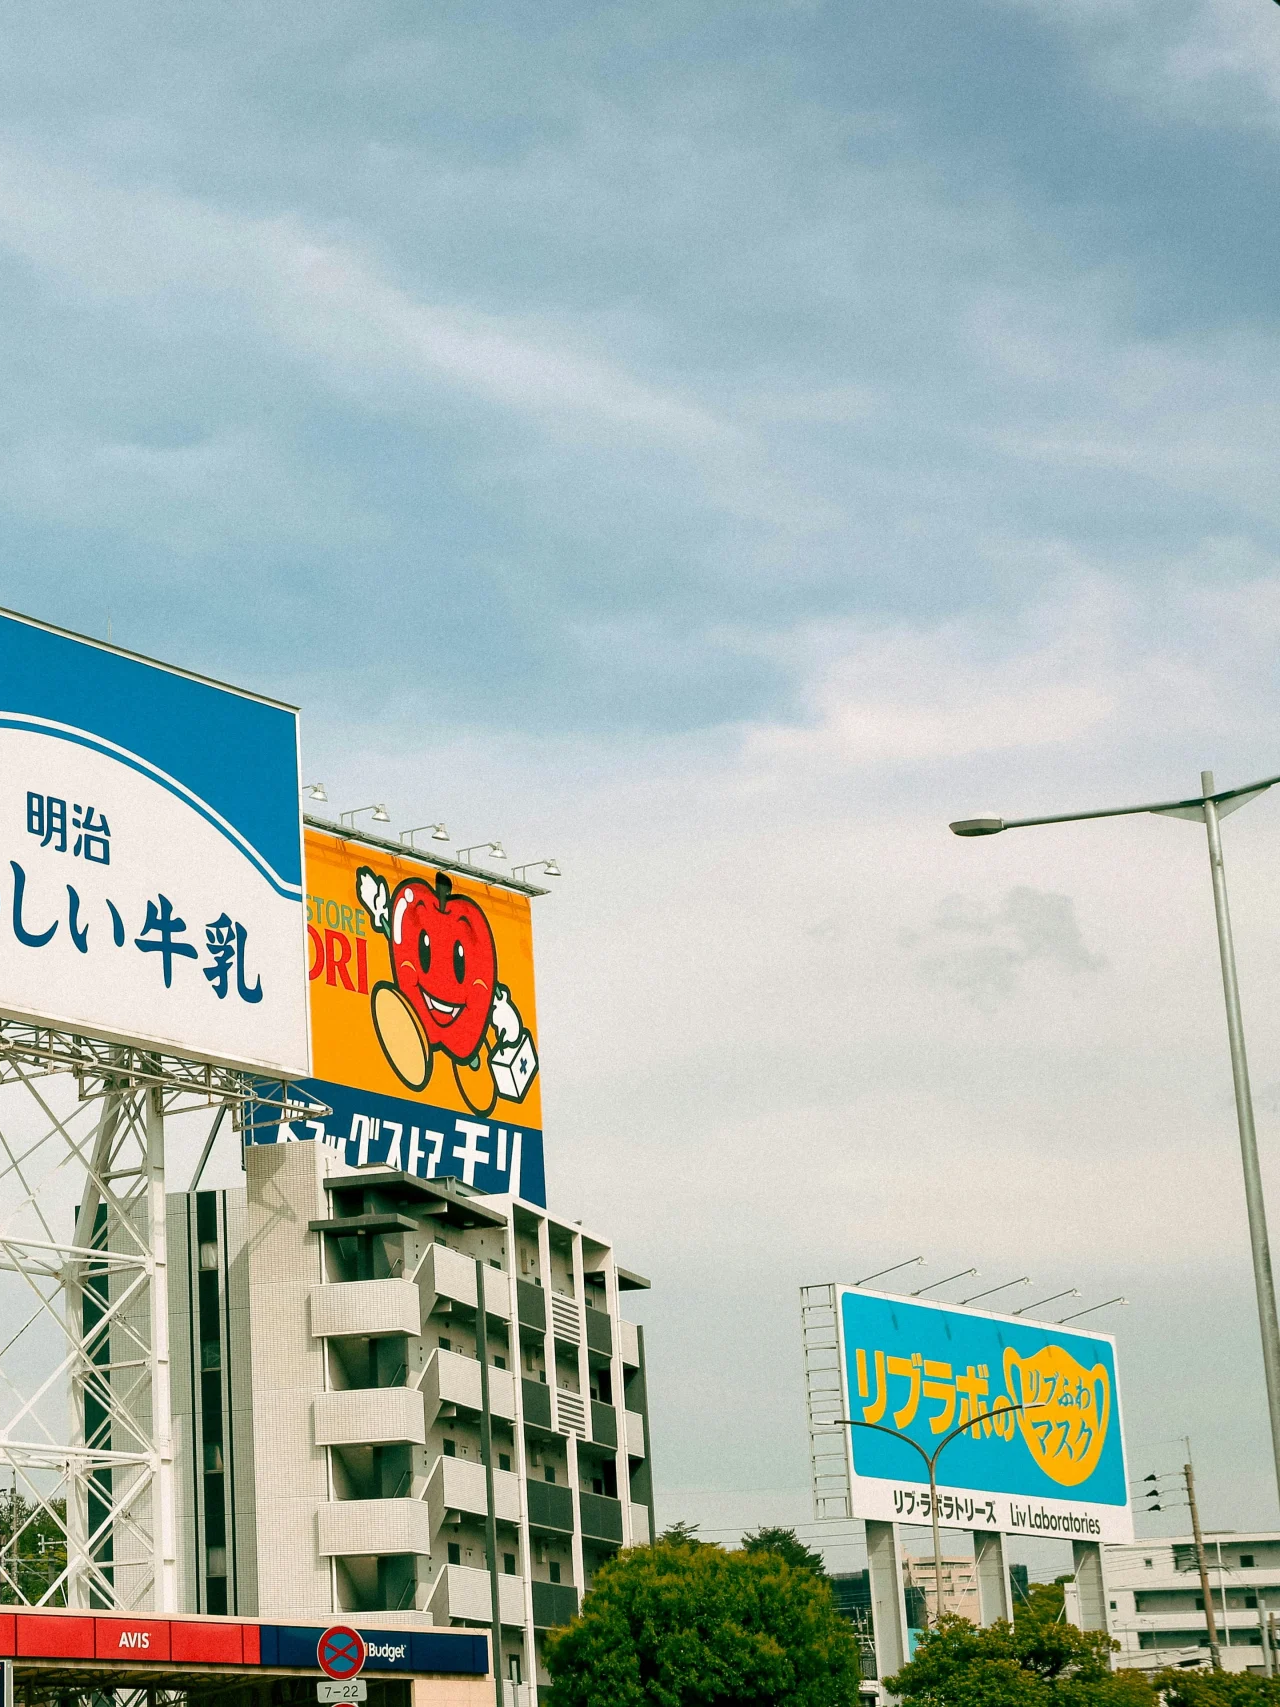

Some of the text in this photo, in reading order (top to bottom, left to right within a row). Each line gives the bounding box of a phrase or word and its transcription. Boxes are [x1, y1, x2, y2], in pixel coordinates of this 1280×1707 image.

[26, 791, 111, 866] 明治
[856, 1348, 1015, 1442] リブラボの
[1028, 1368, 1091, 1410] リブふわ
[1031, 1417, 1093, 1463] マスク
[1010, 1502, 1026, 1528] Liv
[1028, 1504, 1101, 1534] Laboratories
[118, 1631, 150, 1649] AVIS
[369, 1643, 405, 1662] Budget
[324, 1685, 359, 1698] 7-22
